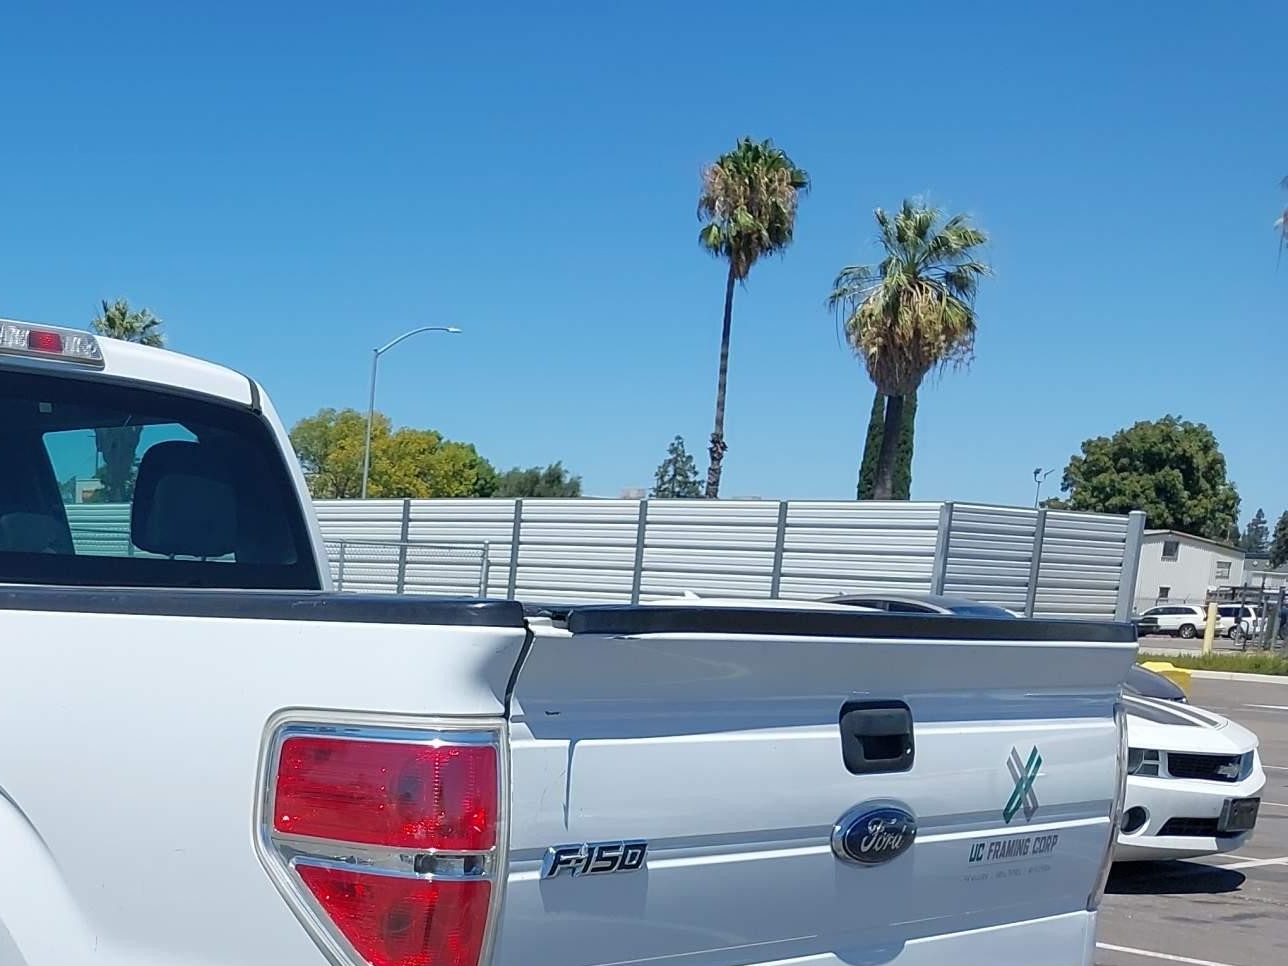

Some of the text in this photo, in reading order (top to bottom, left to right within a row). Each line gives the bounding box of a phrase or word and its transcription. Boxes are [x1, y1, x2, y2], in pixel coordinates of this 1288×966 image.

[860, 817, 907, 853] Ford
[968, 834, 1059, 862] UC FRAMING CORP
